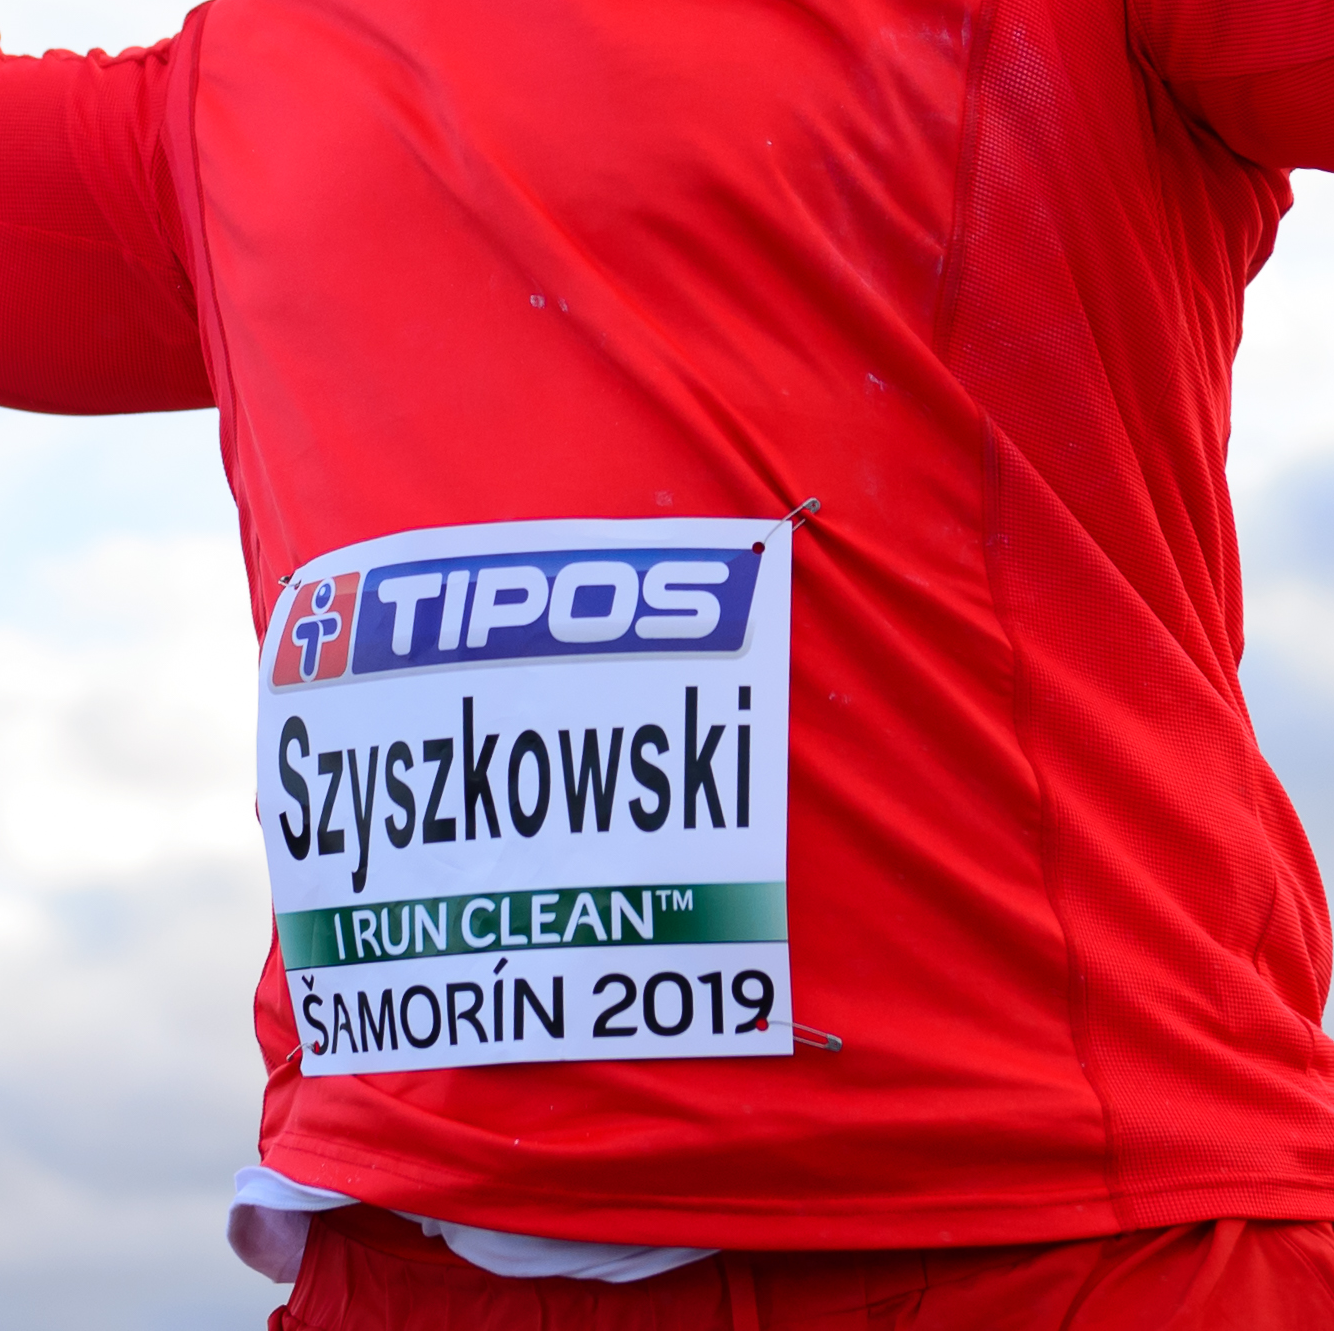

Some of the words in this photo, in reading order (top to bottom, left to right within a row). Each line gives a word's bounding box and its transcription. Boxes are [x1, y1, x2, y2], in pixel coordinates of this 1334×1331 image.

[377, 560, 729, 656] TIPOS
[279, 685, 752, 893] Szyszkowski
[334, 912, 347, 960] I
[352, 902, 447, 959] RUN
[301, 957, 564, 1056] ŠAMORÍN
[592, 969, 775, 1039] 2019
